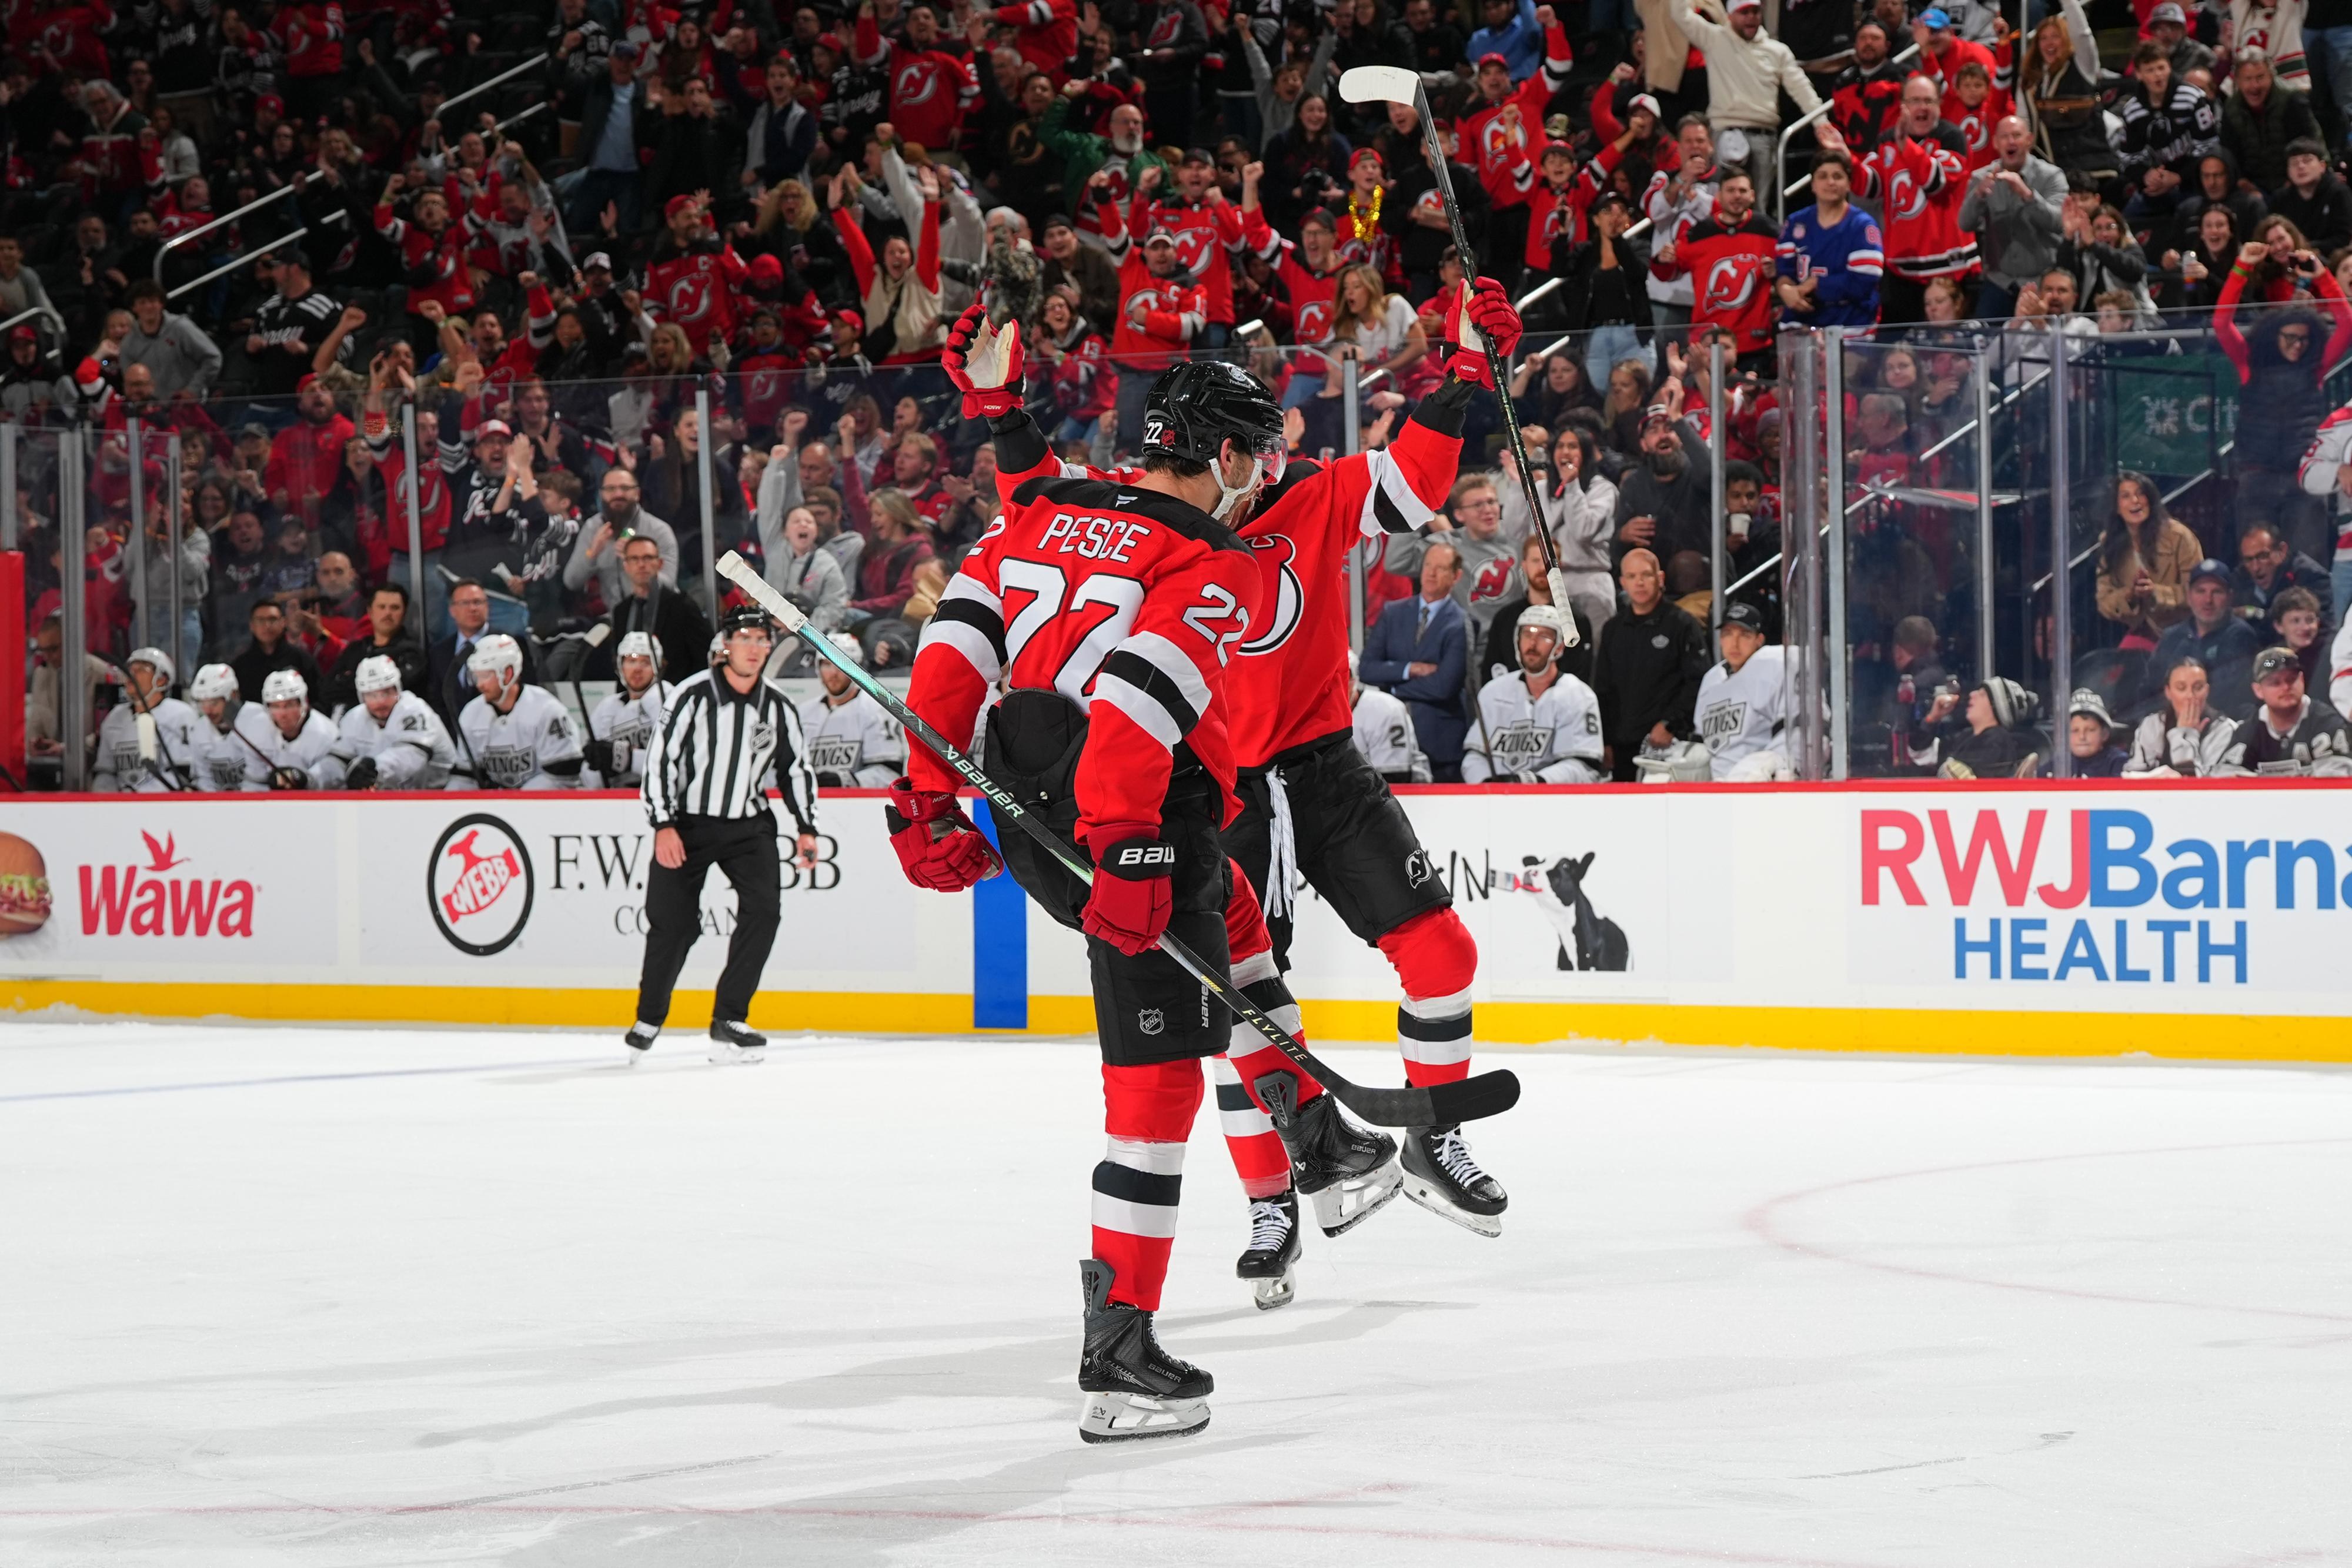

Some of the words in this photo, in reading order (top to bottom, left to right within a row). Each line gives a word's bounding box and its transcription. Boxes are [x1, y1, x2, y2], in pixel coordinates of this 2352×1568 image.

[1146, 422, 1163, 445] 22
[1037, 513, 1150, 563] PESCE
[1181, 583, 1250, 668] 22
[402, 712, 429, 731] 21
[1494, 731, 1545, 754] KINGS
[1585, 713, 1600, 735] 6
[2311, 730, 2349, 760] 24
[549, 834, 645, 890] F.W.
[1860, 809, 2352, 910] RWJBarn
[78, 864, 254, 937] Wawa
[451, 854, 510, 914] WEBB
[1954, 917, 2248, 984] HEALTH
[1144, 1014, 1160, 1031] NHL
[1201, 983, 1210, 1028] AUER
[1242, 1008, 1308, 1062] FLYLITE
[1350, 1143, 1377, 1156] BAUER
[1147, 1362, 1182, 1384] BAUER
